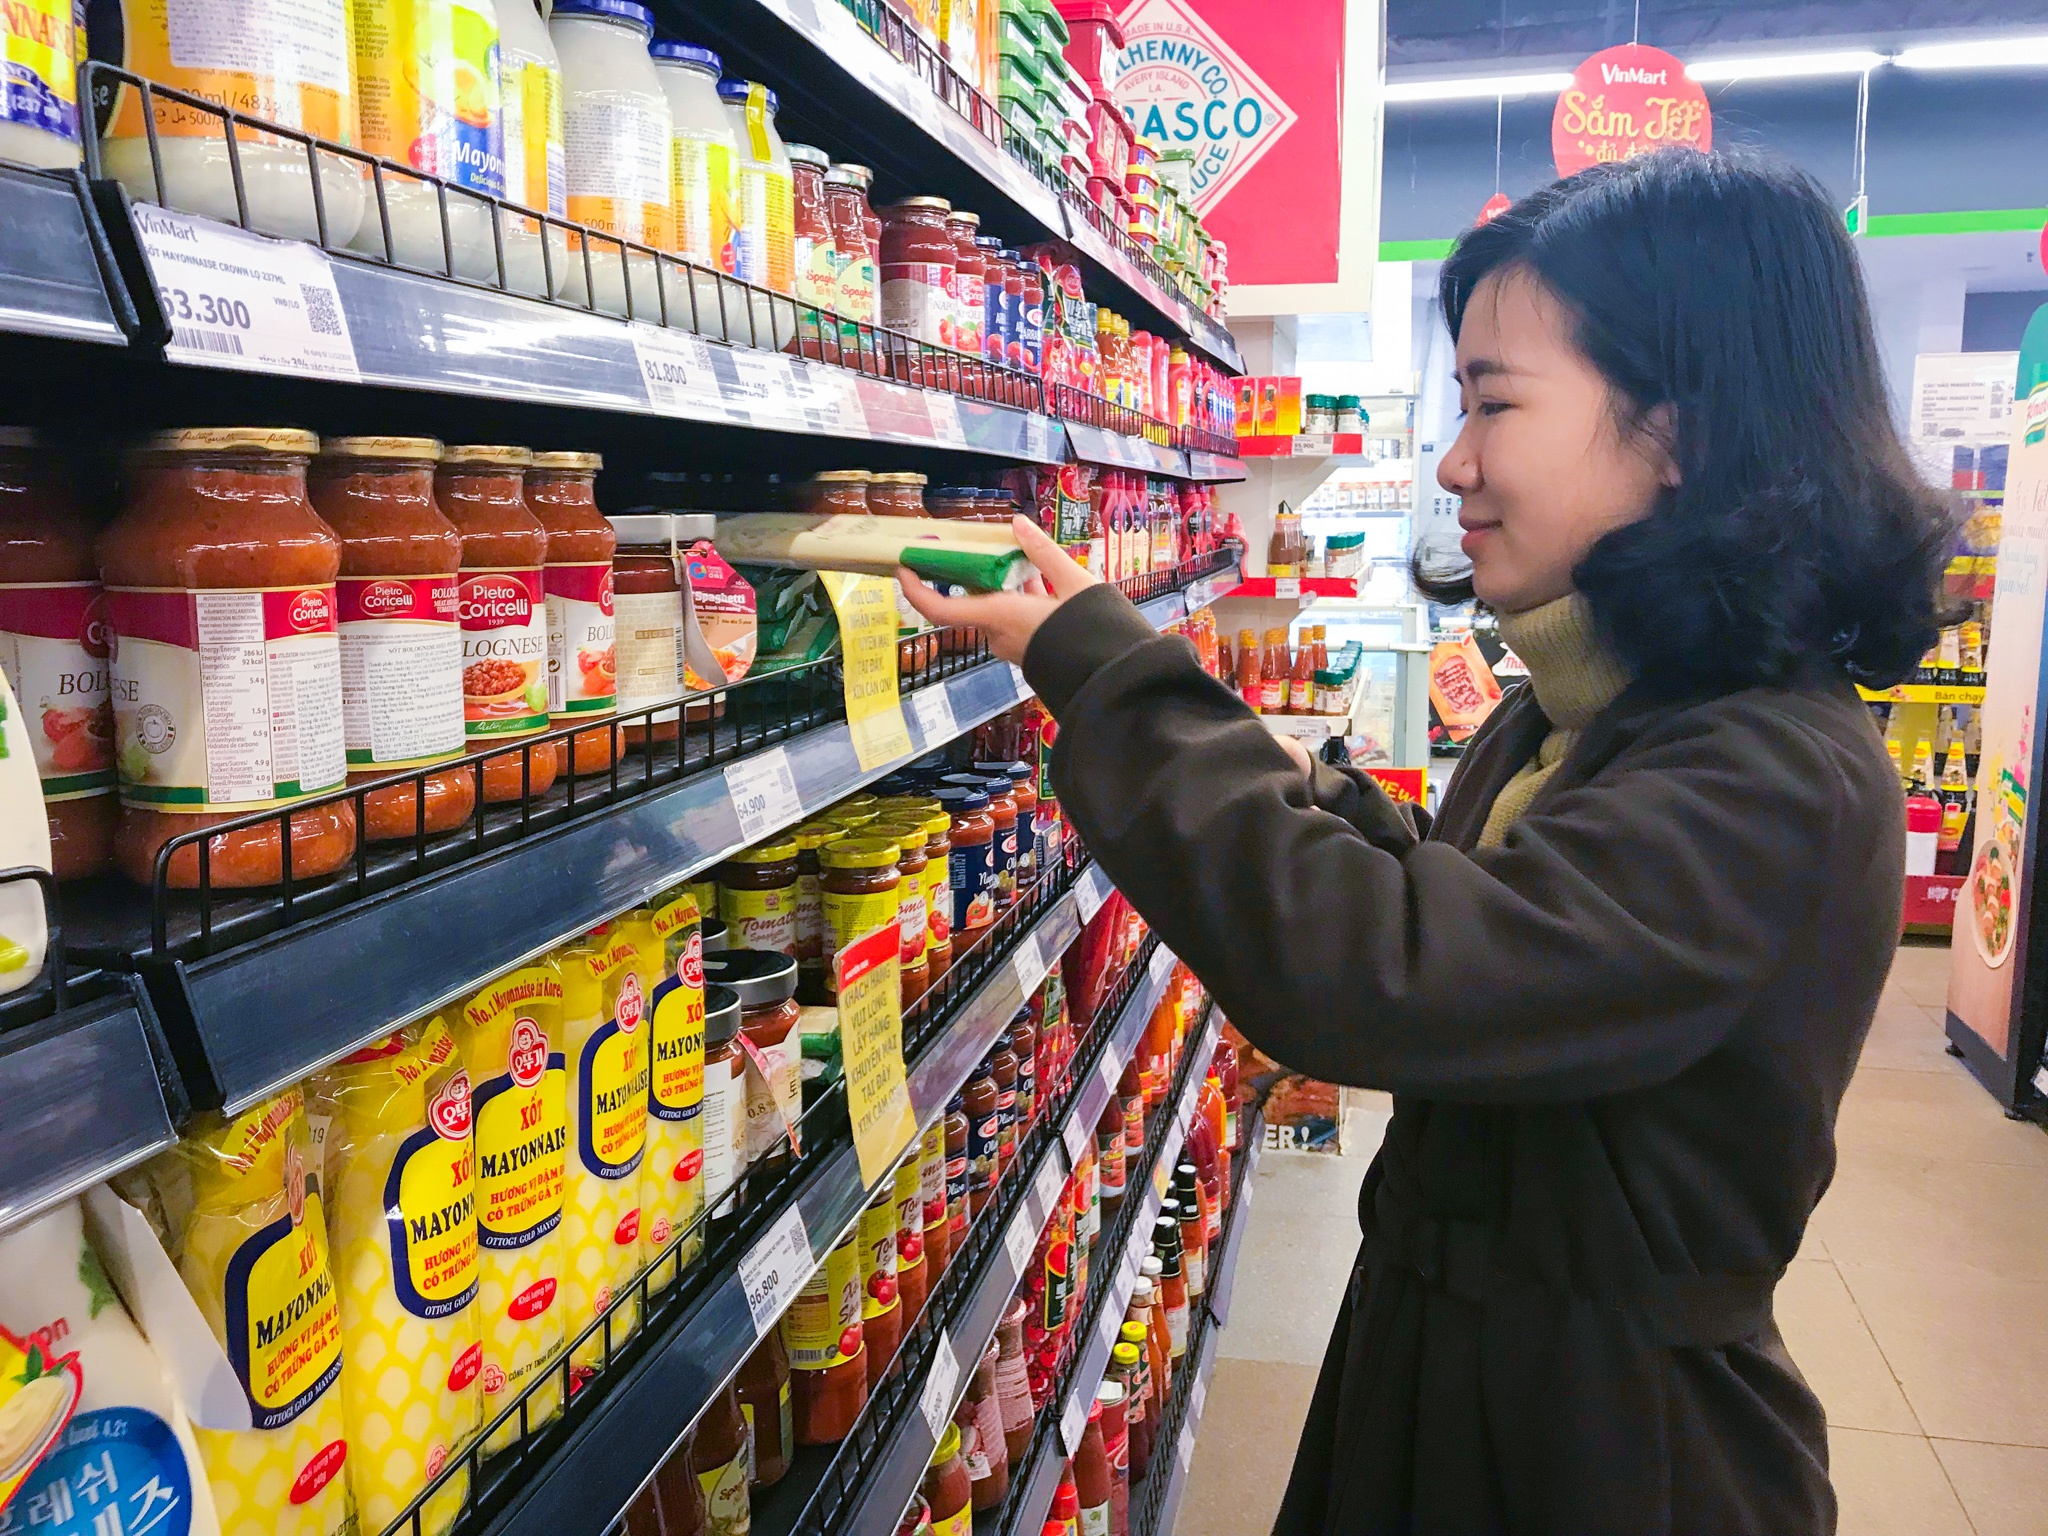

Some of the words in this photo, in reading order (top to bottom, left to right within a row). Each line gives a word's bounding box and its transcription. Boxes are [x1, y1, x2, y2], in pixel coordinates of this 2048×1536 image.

[1153, 22, 1164, 32] IN
[1123, 71, 1155, 92] AVERY
[1155, 71, 1190, 90] ISLAND
[1600, 62, 1667, 85] VinMart
[1190, 143, 1229, 196] UCE
[134, 209, 198, 243] VinMart
[163, 249, 217, 270] MAYONNAISE
[218, 262, 249, 277] CROWN
[644, 359, 687, 385] 81.800
[302, 598, 322, 607] Pietro
[365, 594, 412, 608] Coricelli
[375, 586, 402, 596] Pietro
[472, 585, 515, 600] Pietro
[695, 590, 745, 604] Spaghetti
[293, 606, 329, 622] Coricelli
[458, 599, 528, 620] Coricelli
[463, 635, 543, 658] LOGNESE
[737, 794, 766, 819] 64.900
[492, 979, 535, 1012] Mayonnaise
[536, 978, 544, 997] in
[467, 1006, 492, 1027] No.
[489, 1001, 498, 1016] 1
[621, 1000, 640, 1021] 오뚜기
[852, 1007, 867, 1031] VUI
[515, 1047, 544, 1074] 오뚜기
[663, 1064, 691, 1082] HƯƠNG
[660, 1084, 673, 1098] CÓ
[520, 1089, 543, 1132] XỐT
[658, 1107, 681, 1119] OTTOGI
[682, 1106, 697, 1118] GOLD
[857, 1113, 873, 1138] XIN
[601, 1141, 614, 1155] CÓ
[490, 1183, 527, 1205] HƯƠNG
[537, 1168, 558, 1186] ĐẬM
[487, 1205, 504, 1223] CÓ
[507, 1193, 537, 1218] TRỨNG
[538, 1184, 552, 1202] GÀ
[486, 1236, 517, 1247] OTTOGI
[519, 1230, 536, 1244] GOLD
[298, 1229, 317, 1280] XỐT
[424, 1241, 461, 1272] HƯƠNG
[423, 1272, 440, 1291] CÓ
[750, 1270, 779, 1311] 96.800
[424, 1301, 453, 1316] OTTOGI
[454, 1290, 470, 1309] GOLD
[267, 1332, 300, 1378] HƯƠNG
[264, 1376, 281, 1399] CÓ
[281, 1345, 313, 1386] TRỨNG
[263, 1405, 294, 1429] OTTOGI
[293, 1390, 314, 1418] GOLD
